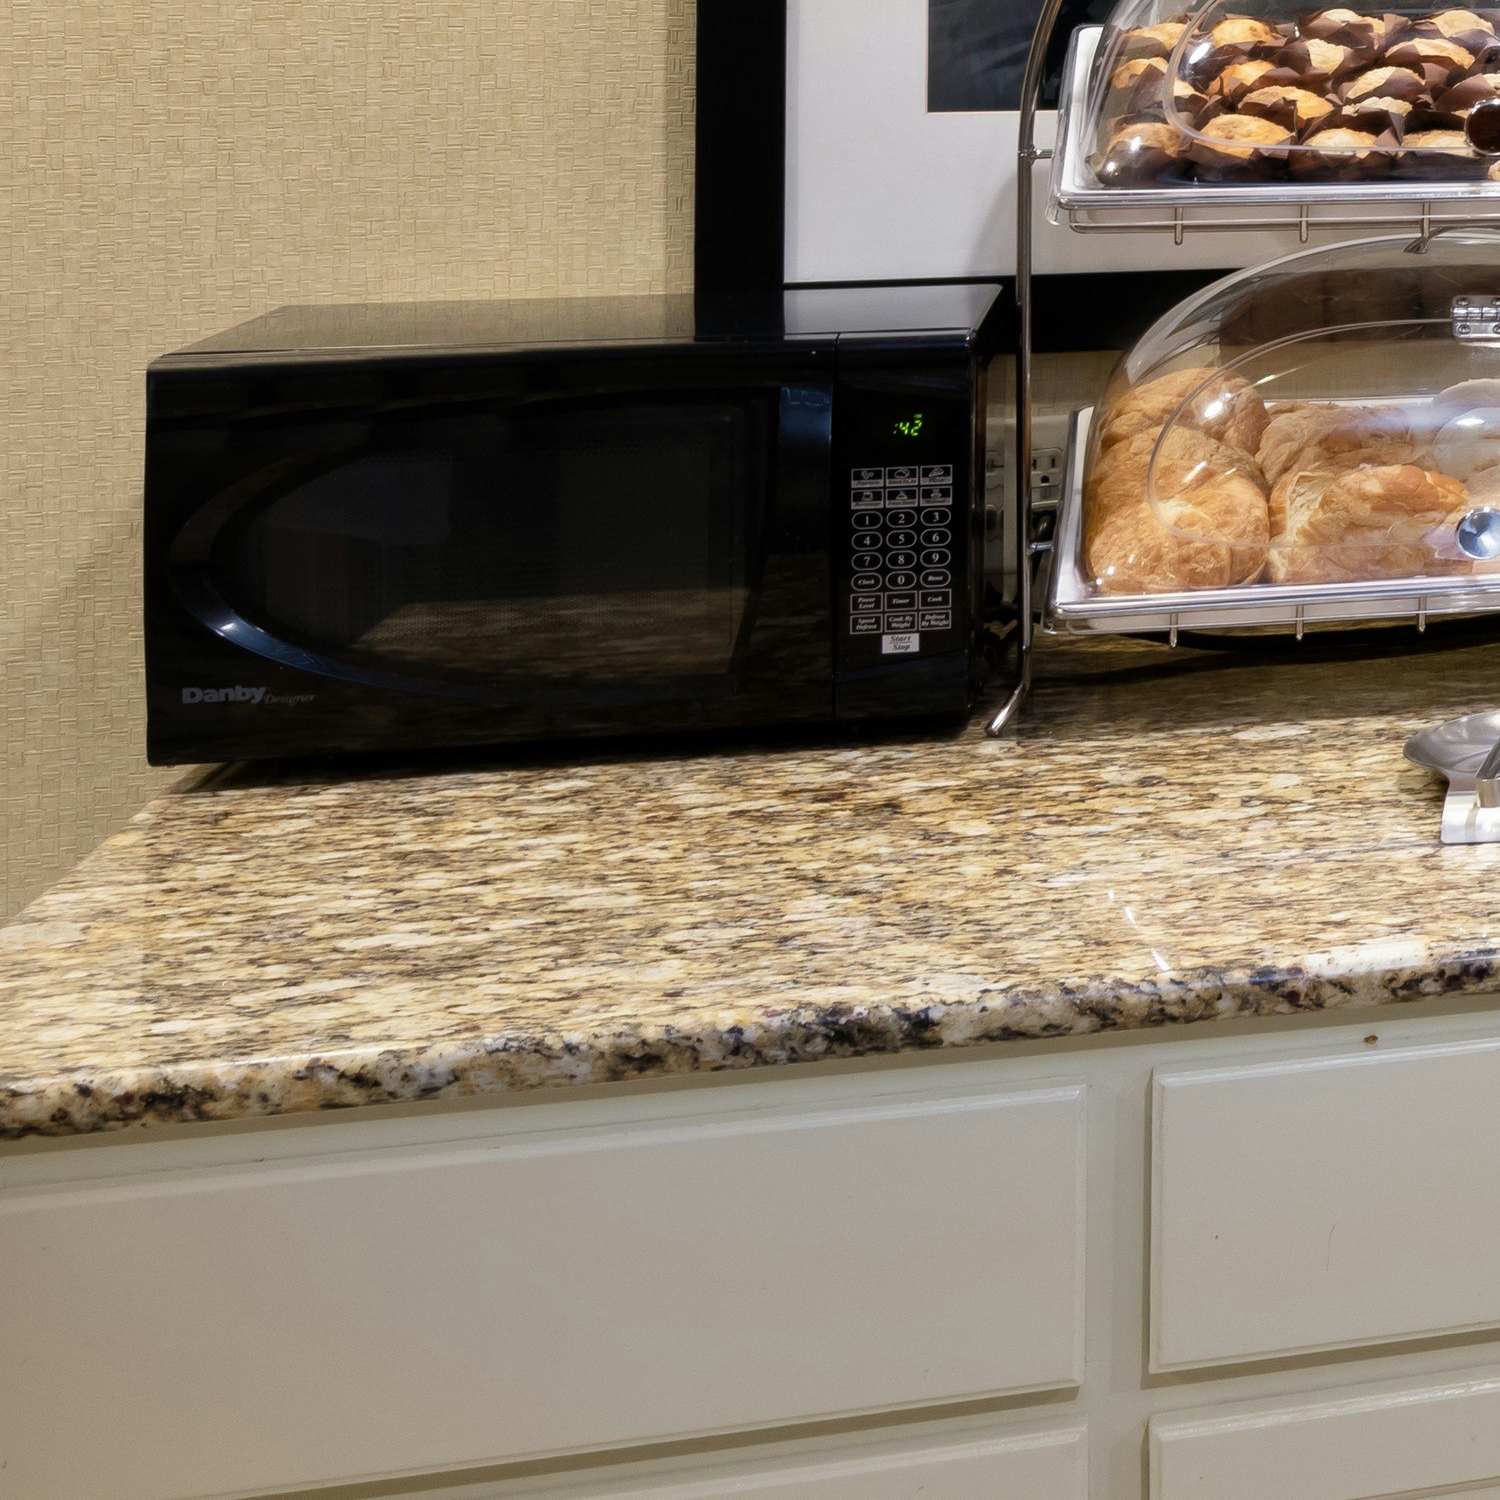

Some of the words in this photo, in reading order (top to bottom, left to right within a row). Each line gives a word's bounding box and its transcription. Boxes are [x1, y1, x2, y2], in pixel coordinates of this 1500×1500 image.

[864, 515, 869, 526] 1
[898, 513, 906, 524] 2
[932, 512, 939, 522] 3
[863, 535, 870, 546] 4
[898, 534, 905, 544] 5
[932, 532, 939, 542] 6
[863, 556, 870, 566] 7
[898, 554, 905, 564] 8
[932, 553, 939, 563] 9
[897, 575, 905, 585] 0
